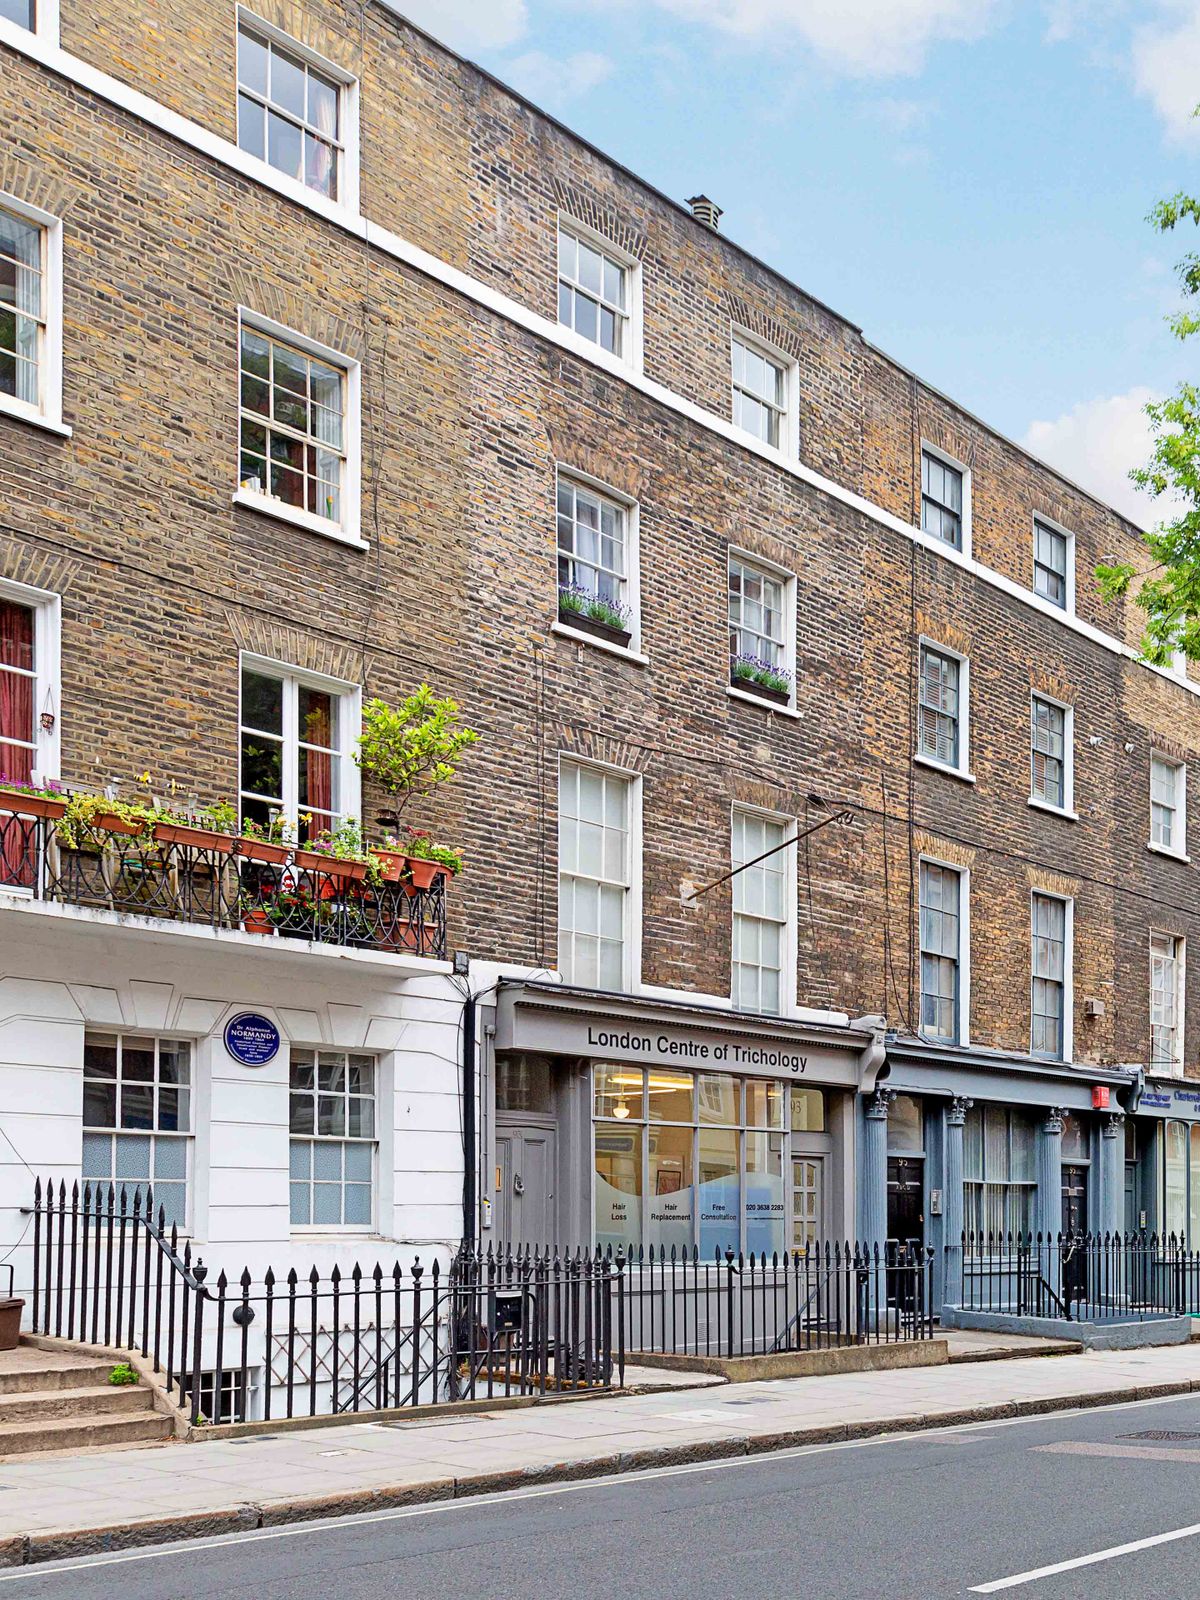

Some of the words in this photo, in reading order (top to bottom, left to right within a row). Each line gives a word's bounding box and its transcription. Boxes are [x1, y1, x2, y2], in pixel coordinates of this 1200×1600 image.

[231, 1029, 276, 1039] NORMANDY
[587, 1027, 652, 1052] London
[656, 1035, 710, 1058] Centre
[713, 1044, 729, 1060] of
[732, 1045, 808, 1073] Trichology
[898, 1158, 908, 1167] 95
[612, 1203, 626, 1211] Hair
[664, 1203, 678, 1211] Hair
[650, 1213, 691, 1222] Replacement
